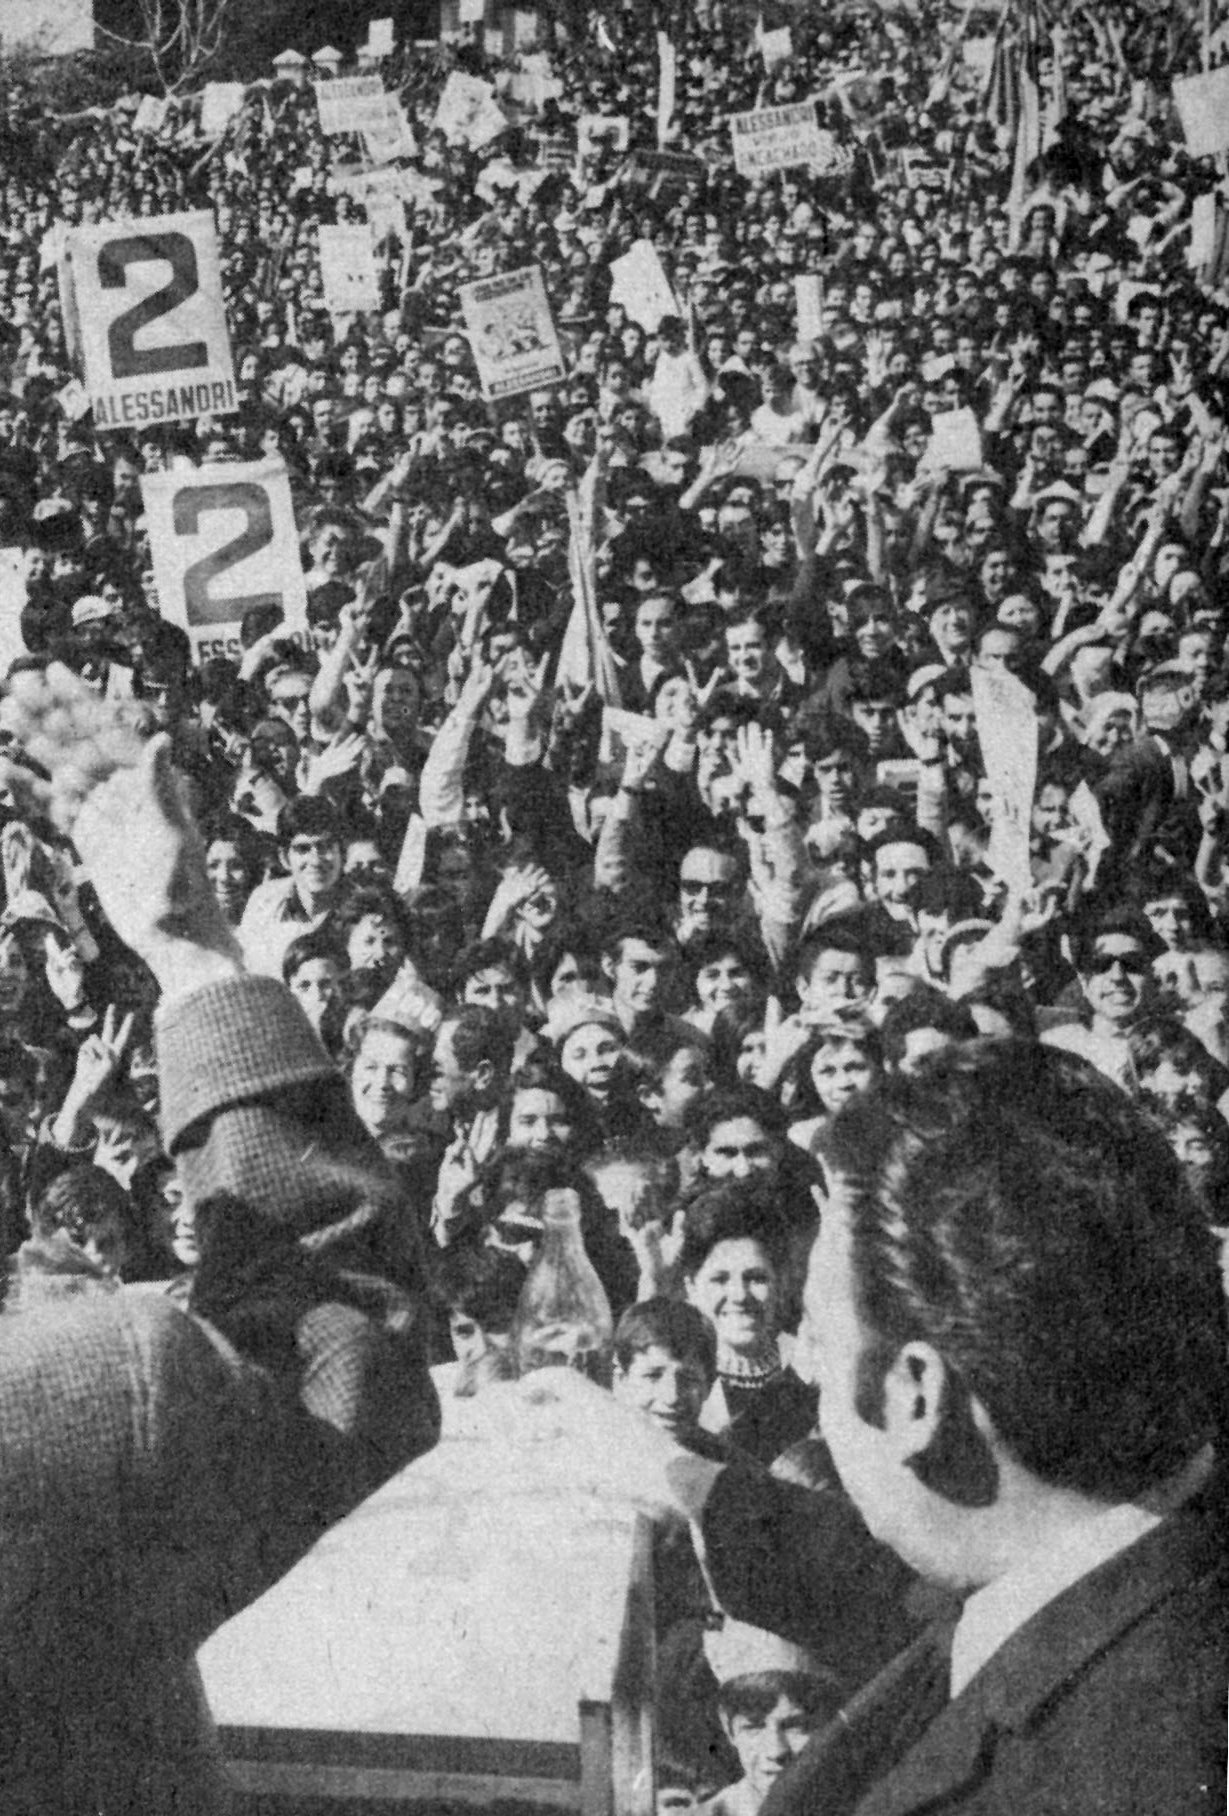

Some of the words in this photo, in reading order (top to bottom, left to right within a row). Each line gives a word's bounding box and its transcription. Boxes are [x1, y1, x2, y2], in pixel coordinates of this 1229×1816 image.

[97, 231, 209, 379] 2
[94, 380, 235, 424] ALESSANDRI
[172, 482, 286, 627] 2
